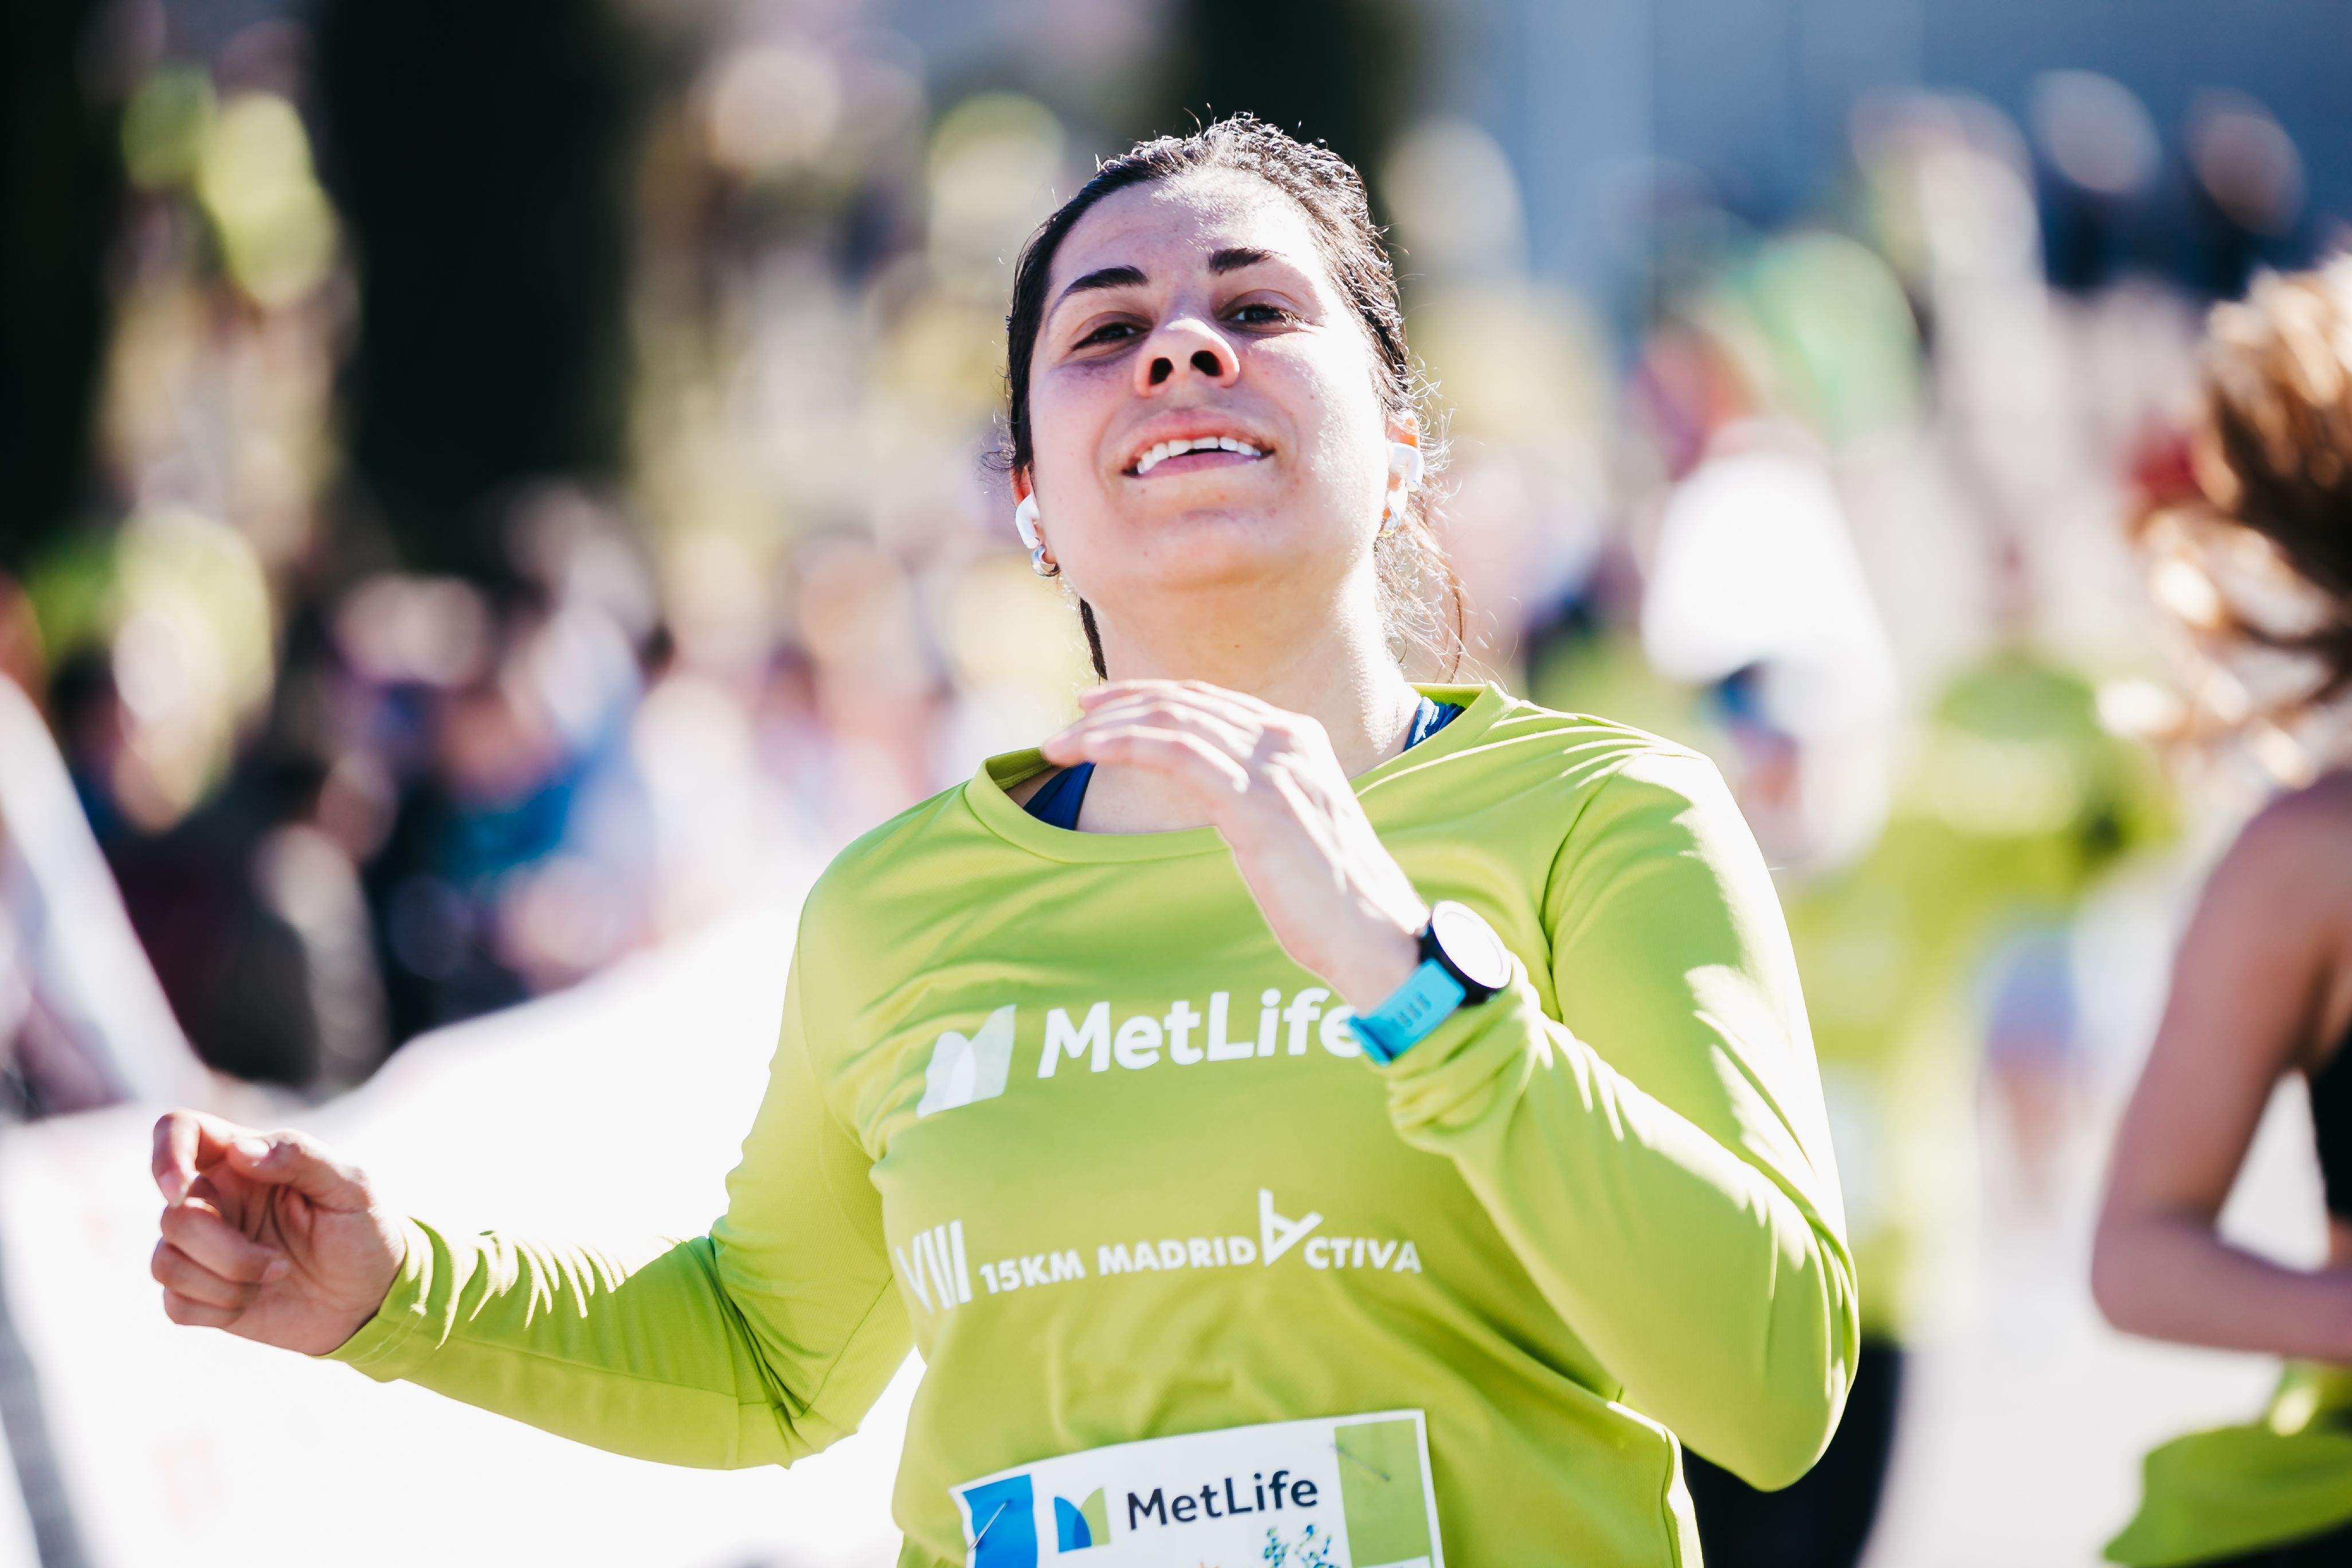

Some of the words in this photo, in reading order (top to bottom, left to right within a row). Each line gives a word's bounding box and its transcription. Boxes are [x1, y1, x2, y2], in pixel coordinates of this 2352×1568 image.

[1038, 988, 1362, 1079] MetLife
[979, 1248, 1085, 1295] 15KM
[1097, 1236, 1256, 1276] MADRID
[1127, 1470, 1318, 1531] MetLife
